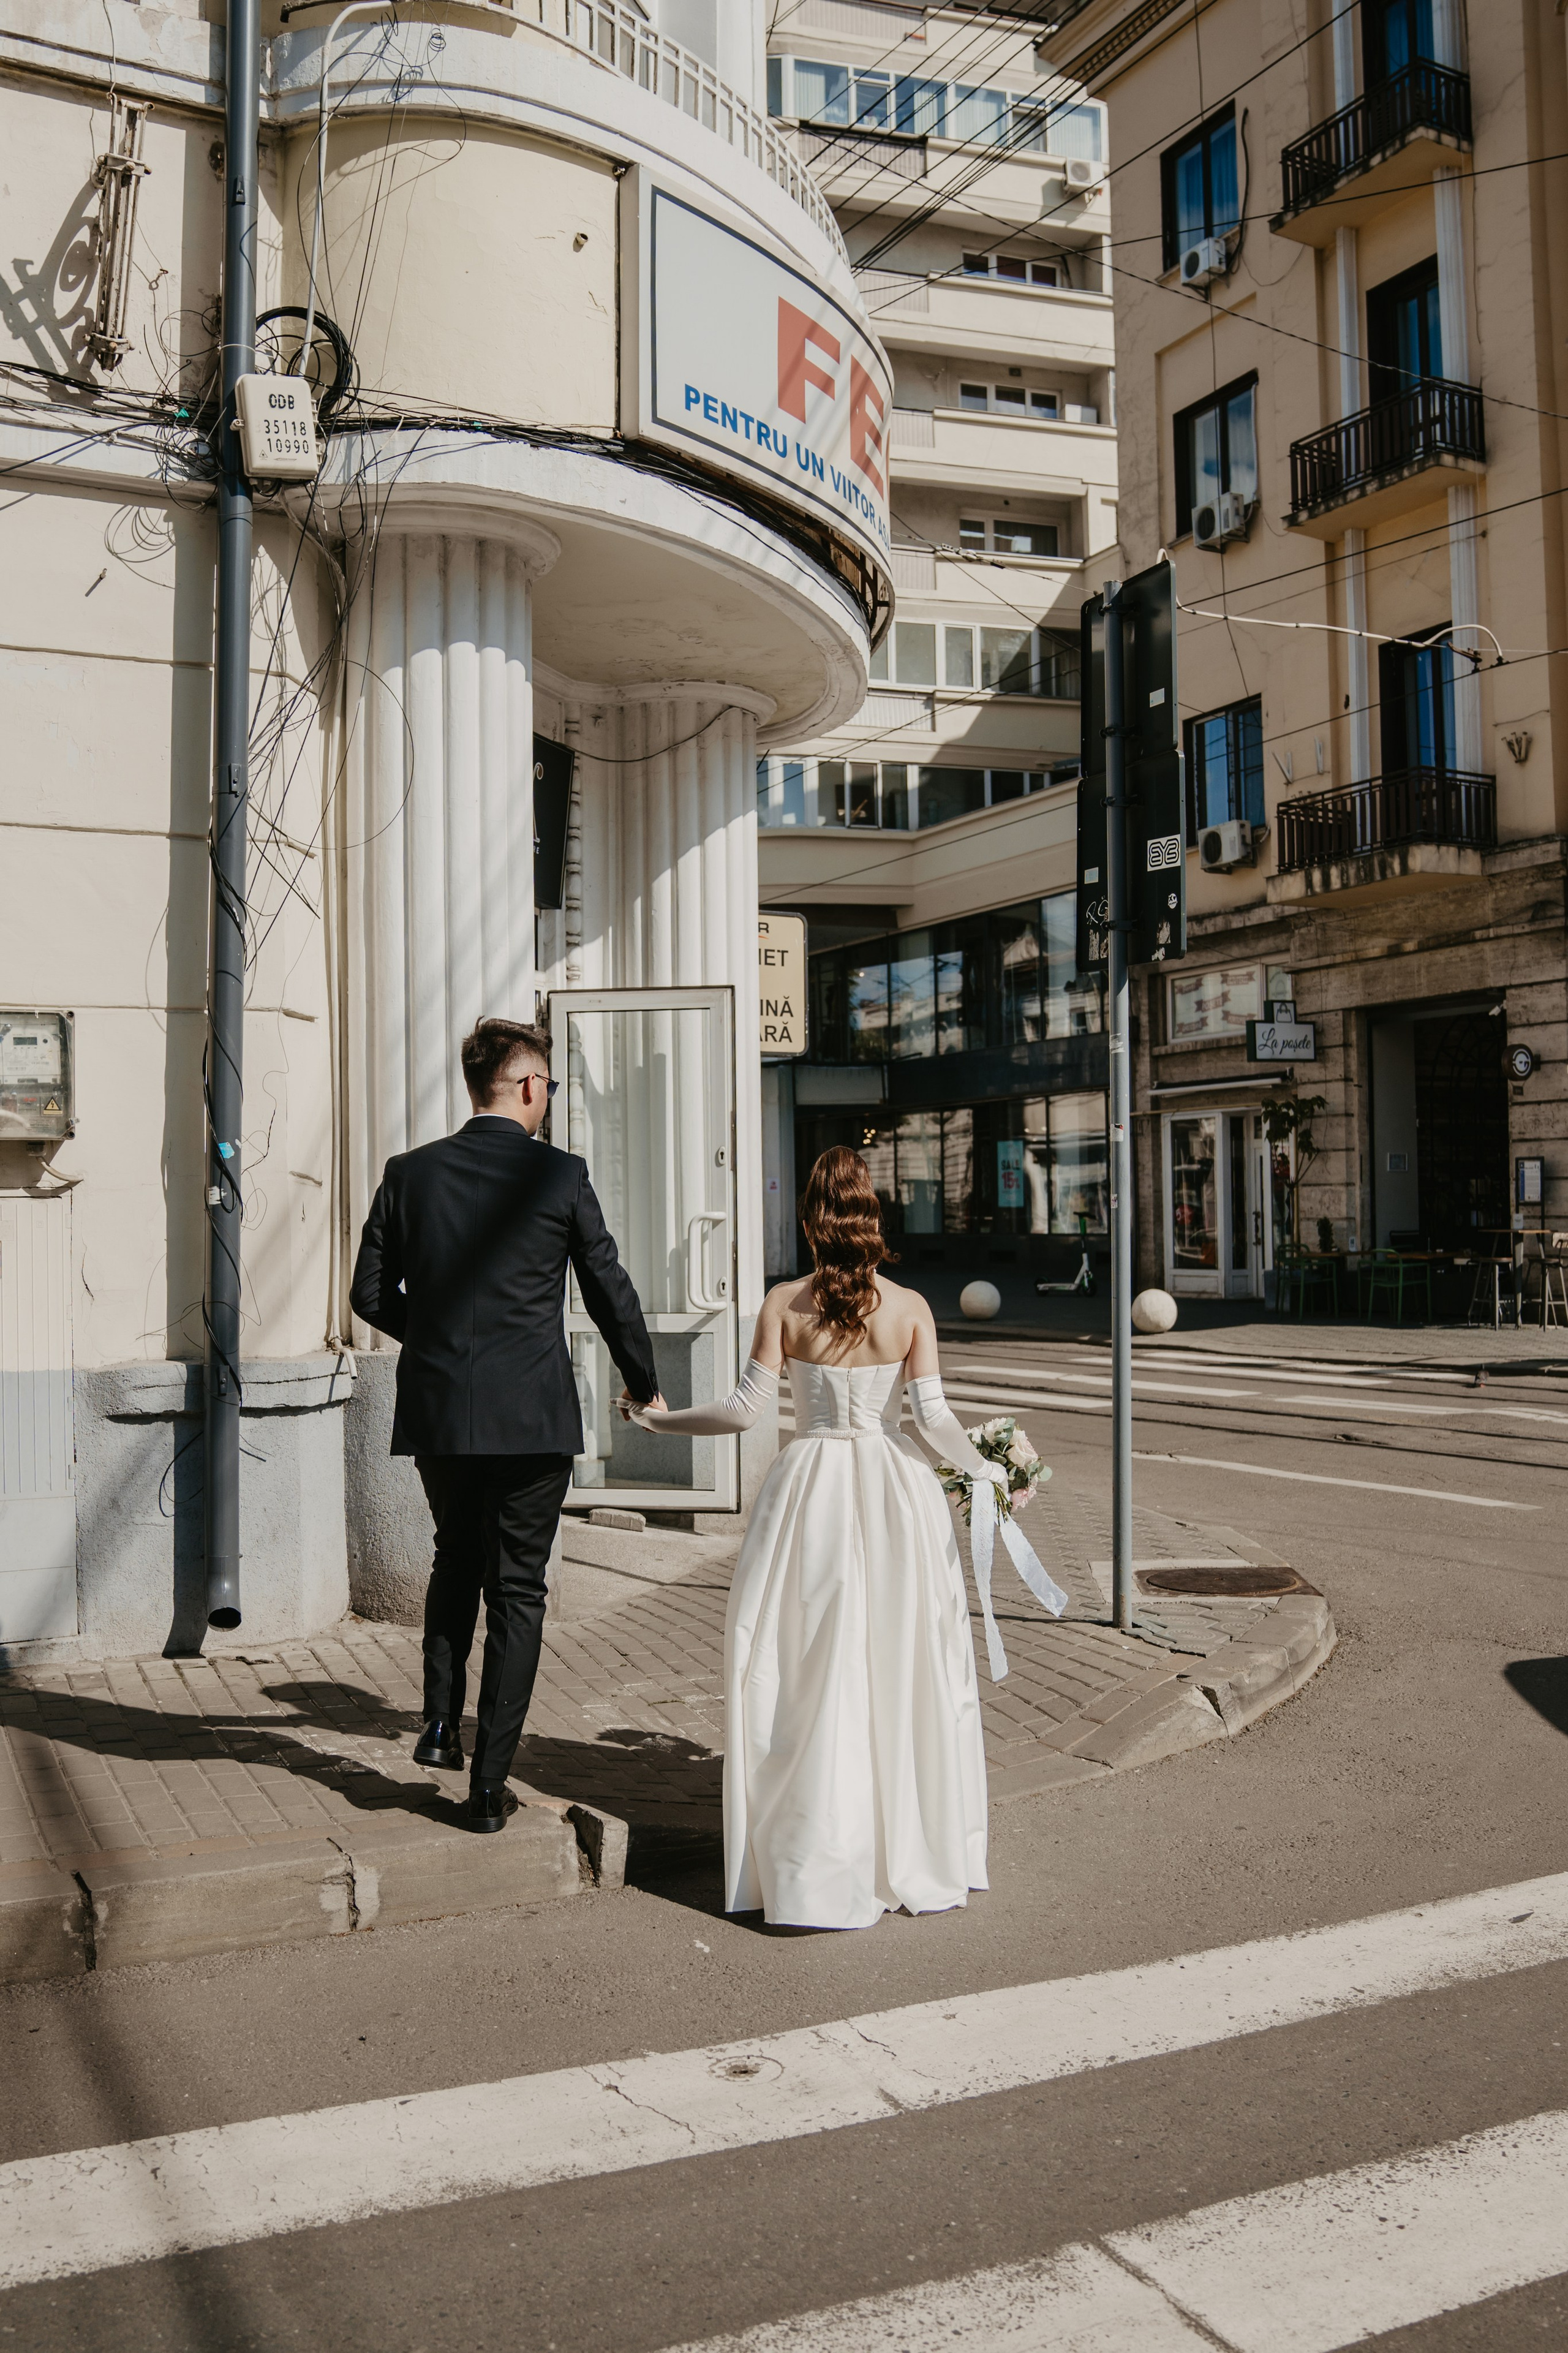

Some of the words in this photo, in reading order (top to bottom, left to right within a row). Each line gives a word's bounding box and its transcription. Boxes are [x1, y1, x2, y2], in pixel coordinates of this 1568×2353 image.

[268, 393, 295, 409] ODB
[777, 295, 890, 502] FE
[263, 419, 307, 436] 35118
[267, 437, 309, 454] 10990
[684, 383, 788, 459] PENTRU
[796, 441, 824, 483] UN
[829, 464, 876, 530] VIITOR
[1257, 1027, 1278, 1055] La
